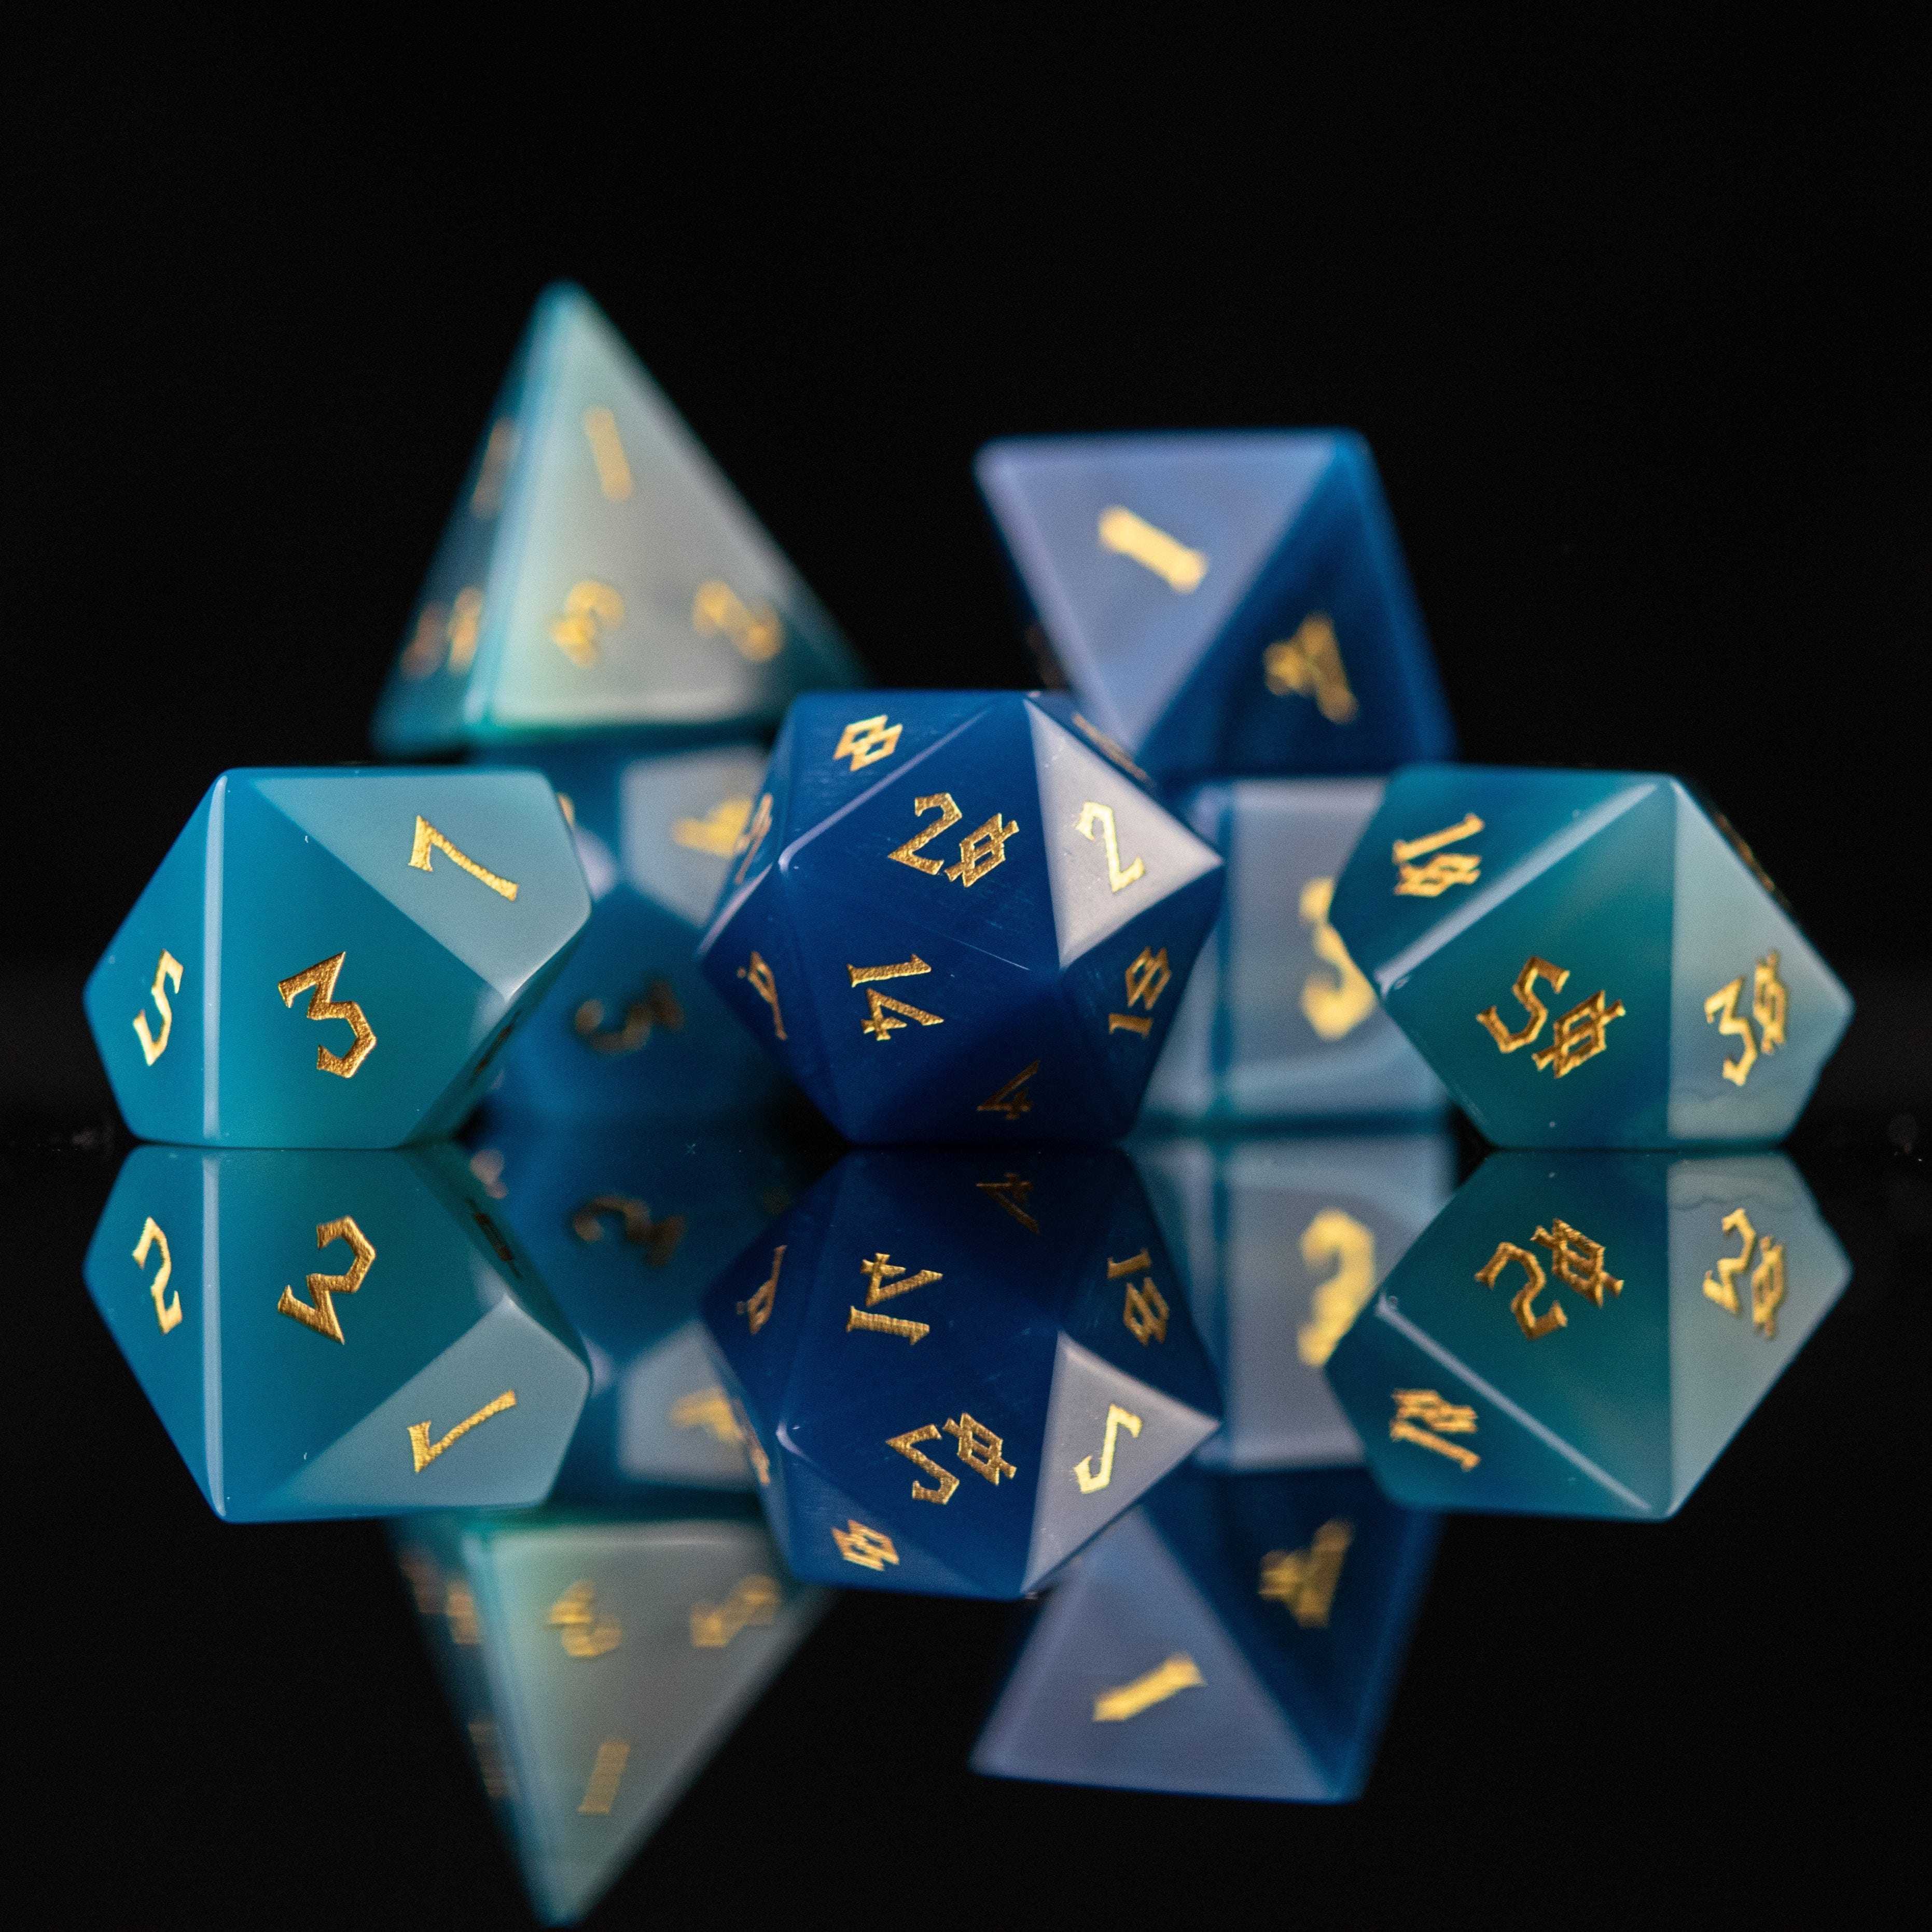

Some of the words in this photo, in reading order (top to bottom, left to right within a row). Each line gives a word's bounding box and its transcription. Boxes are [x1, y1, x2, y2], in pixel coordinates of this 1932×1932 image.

[1098, 506, 1207, 593] 1
[408, 815, 519, 901] 7
[888, 792, 1019, 887] 20
[1075, 801, 1145, 893] 2
[133, 949, 184, 1066] 5
[278, 951, 377, 1078] 3
[846, 953, 944, 1041] 14
[1108, 946, 1172, 1037] 18
[1476, 956, 1626, 1078] 50
[1703, 950, 1789, 1086] 30
[977, 1059, 1040, 1120] 4
